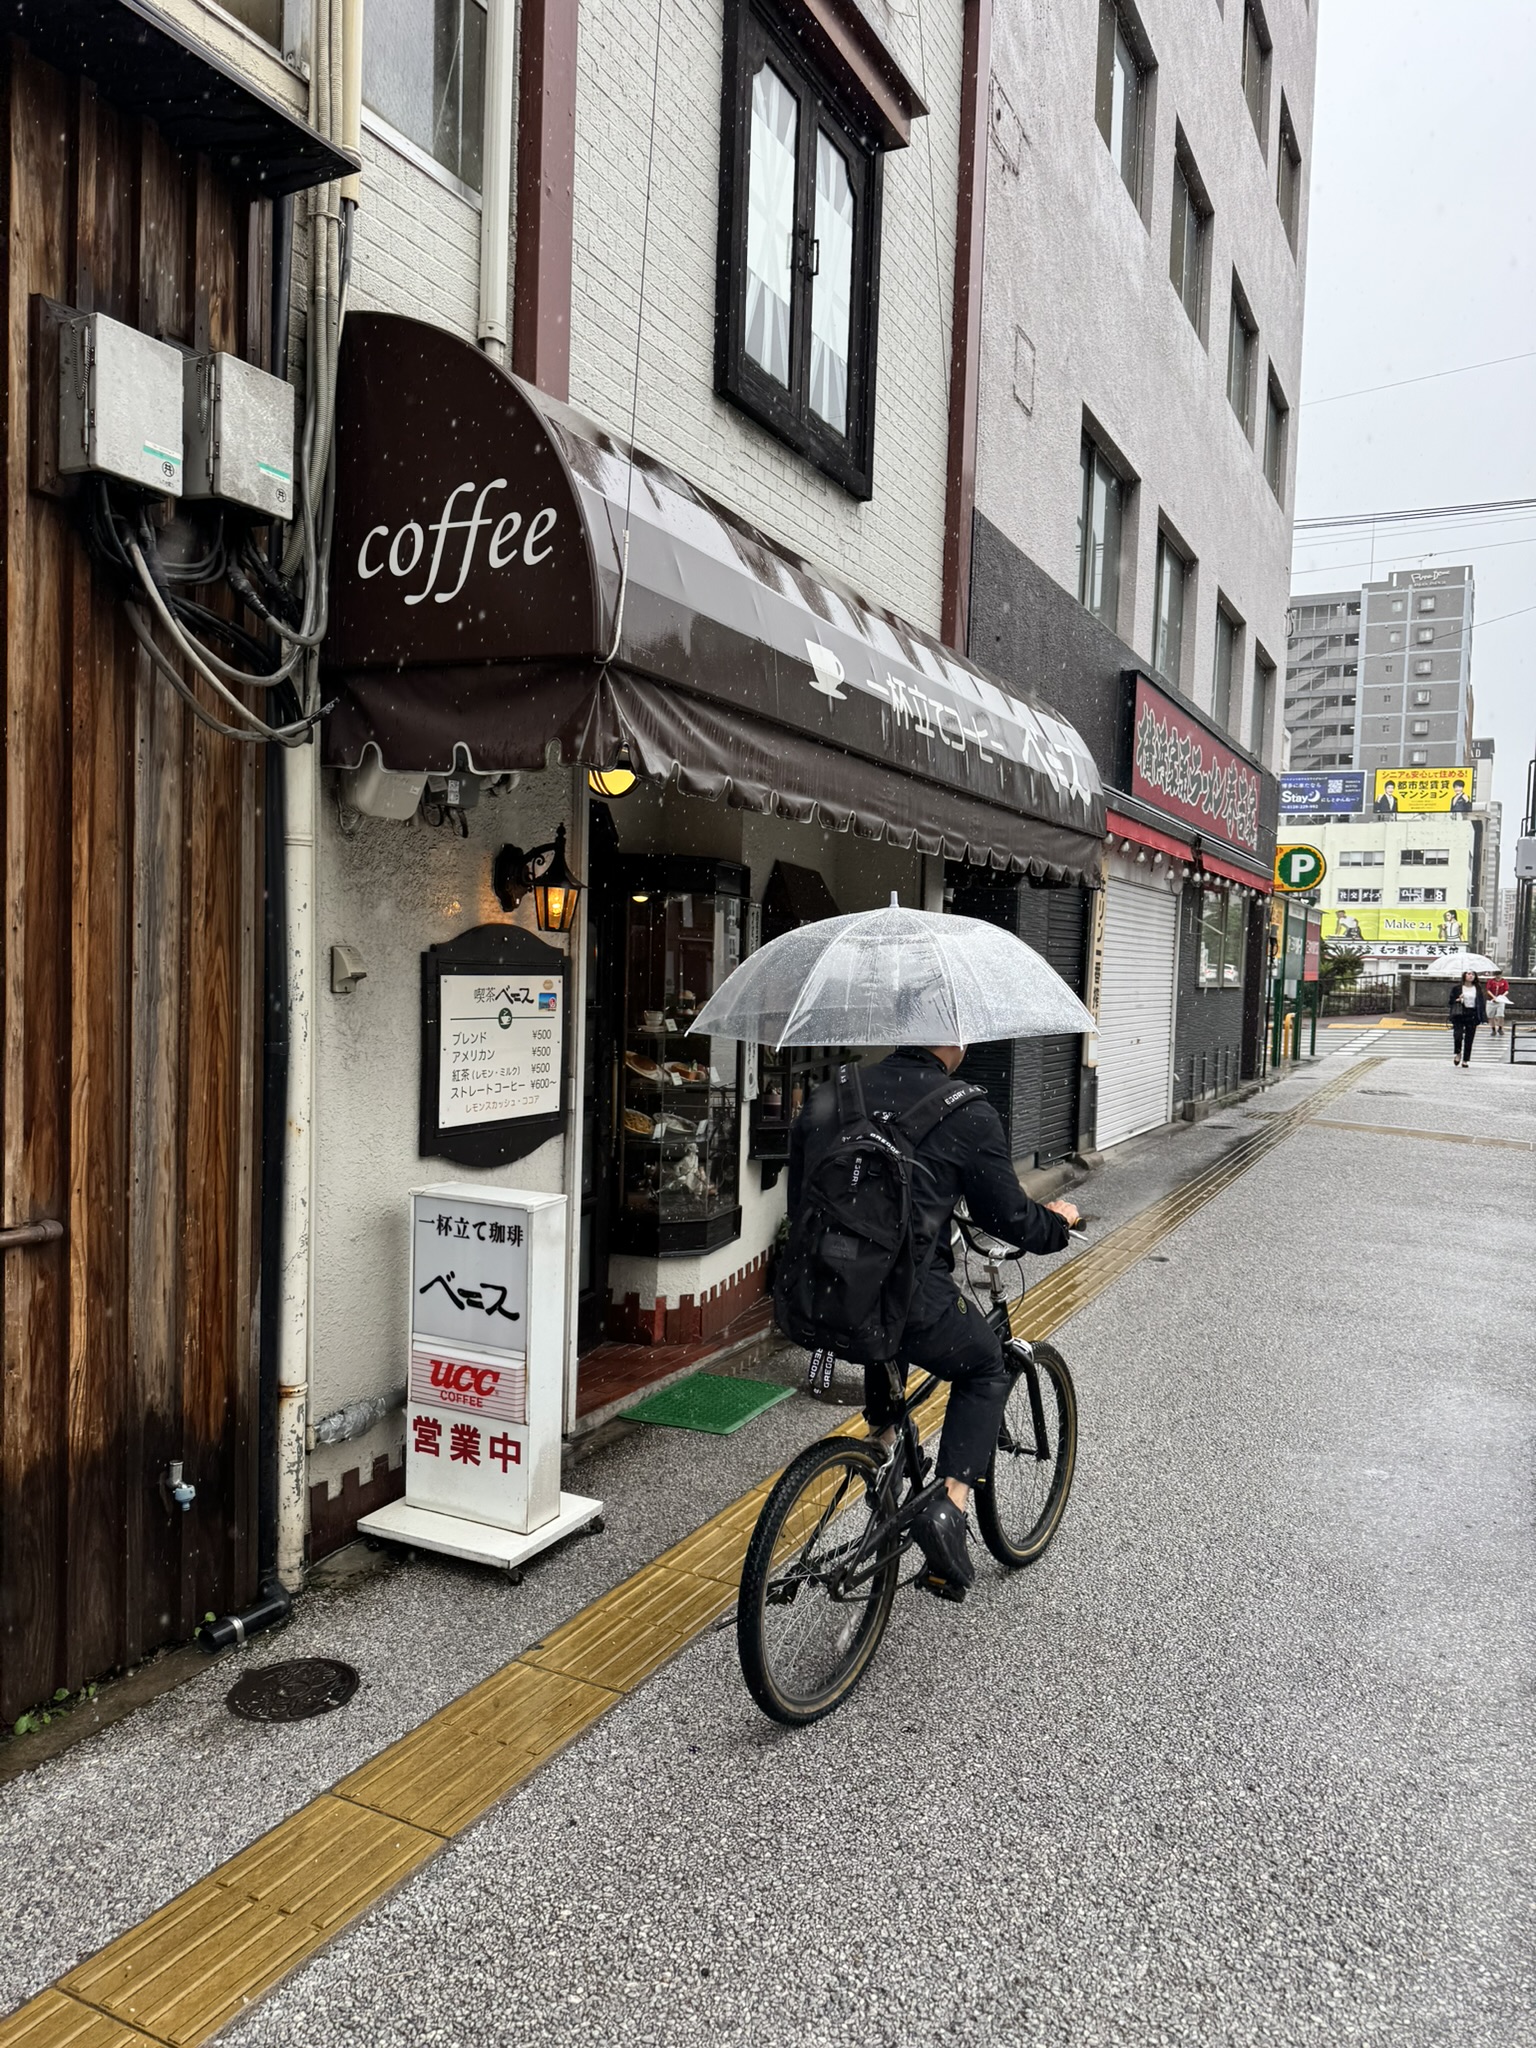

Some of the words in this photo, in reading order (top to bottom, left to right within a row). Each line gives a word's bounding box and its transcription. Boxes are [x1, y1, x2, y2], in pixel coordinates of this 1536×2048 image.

[358, 478, 557, 606] coffee
[1398, 780, 1450, 790] 都市型賃貸
[1282, 790, 1308, 803] Stay
[1399, 791, 1448, 799] マンション
[1290, 853, 1316, 883] P
[1384, 919, 1416, 929] Make
[1419, 921, 1432, 931] 24
[452, 1031, 487, 1046] ブレンド
[532, 1029, 552, 1040] ¥500
[452, 1049, 495, 1063] アメリカン
[531, 1046, 551, 1057] ¥500
[531, 1062, 551, 1073] ¥500
[465, 1095, 540, 1114] レモンスカッシュ・ココア
[418, 1213, 525, 1248] 一杯立て珈琲
[419, 1270, 520, 1322] ベース
[440, 1389, 484, 1409] COFFEE
[413, 1414, 522, 1474] 営業中
